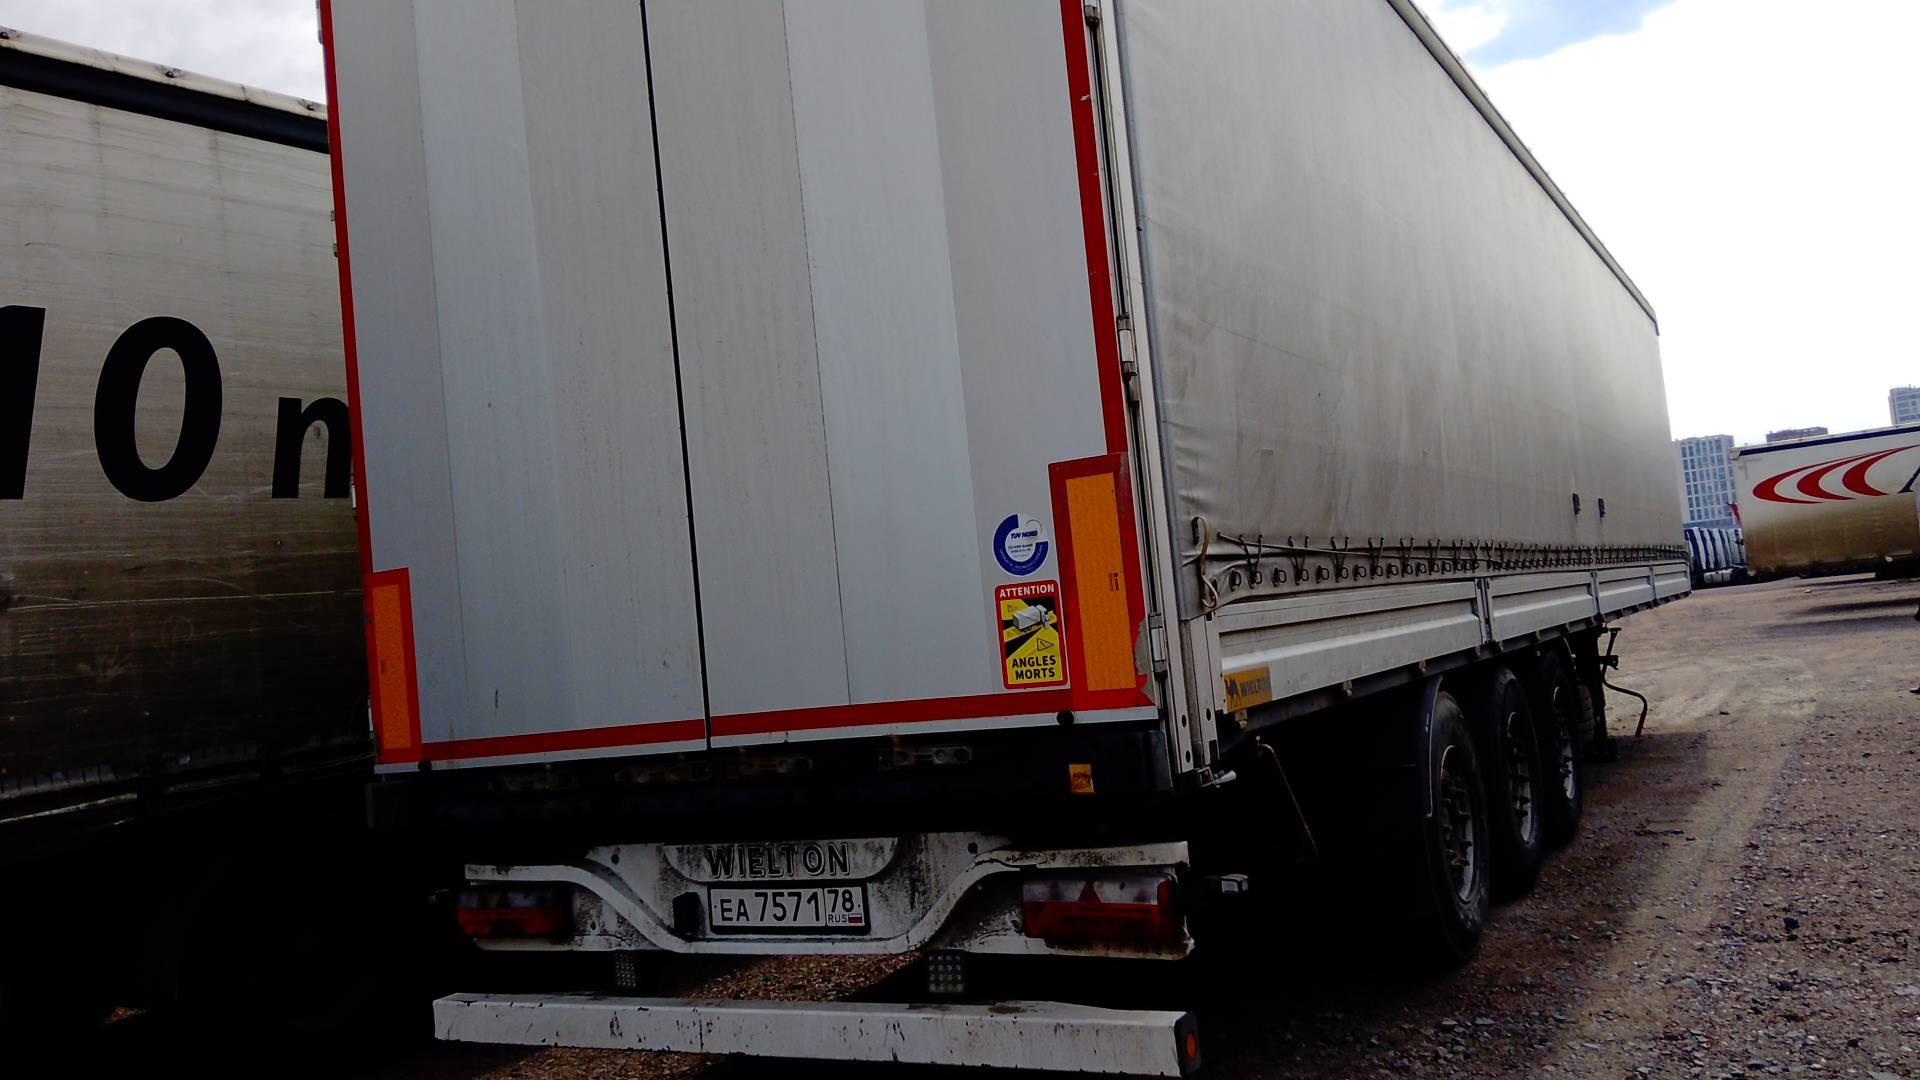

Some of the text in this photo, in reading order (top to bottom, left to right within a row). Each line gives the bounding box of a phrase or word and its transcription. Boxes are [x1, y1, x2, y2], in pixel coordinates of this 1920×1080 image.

[1000, 584, 1054, 598] ATTENTION
[1012, 655, 1056, 669] ANGLES
[1015, 667, 1056, 680] MORTS
[706, 842, 850, 878] WIELTON
[827, 914, 848, 924] RUS
